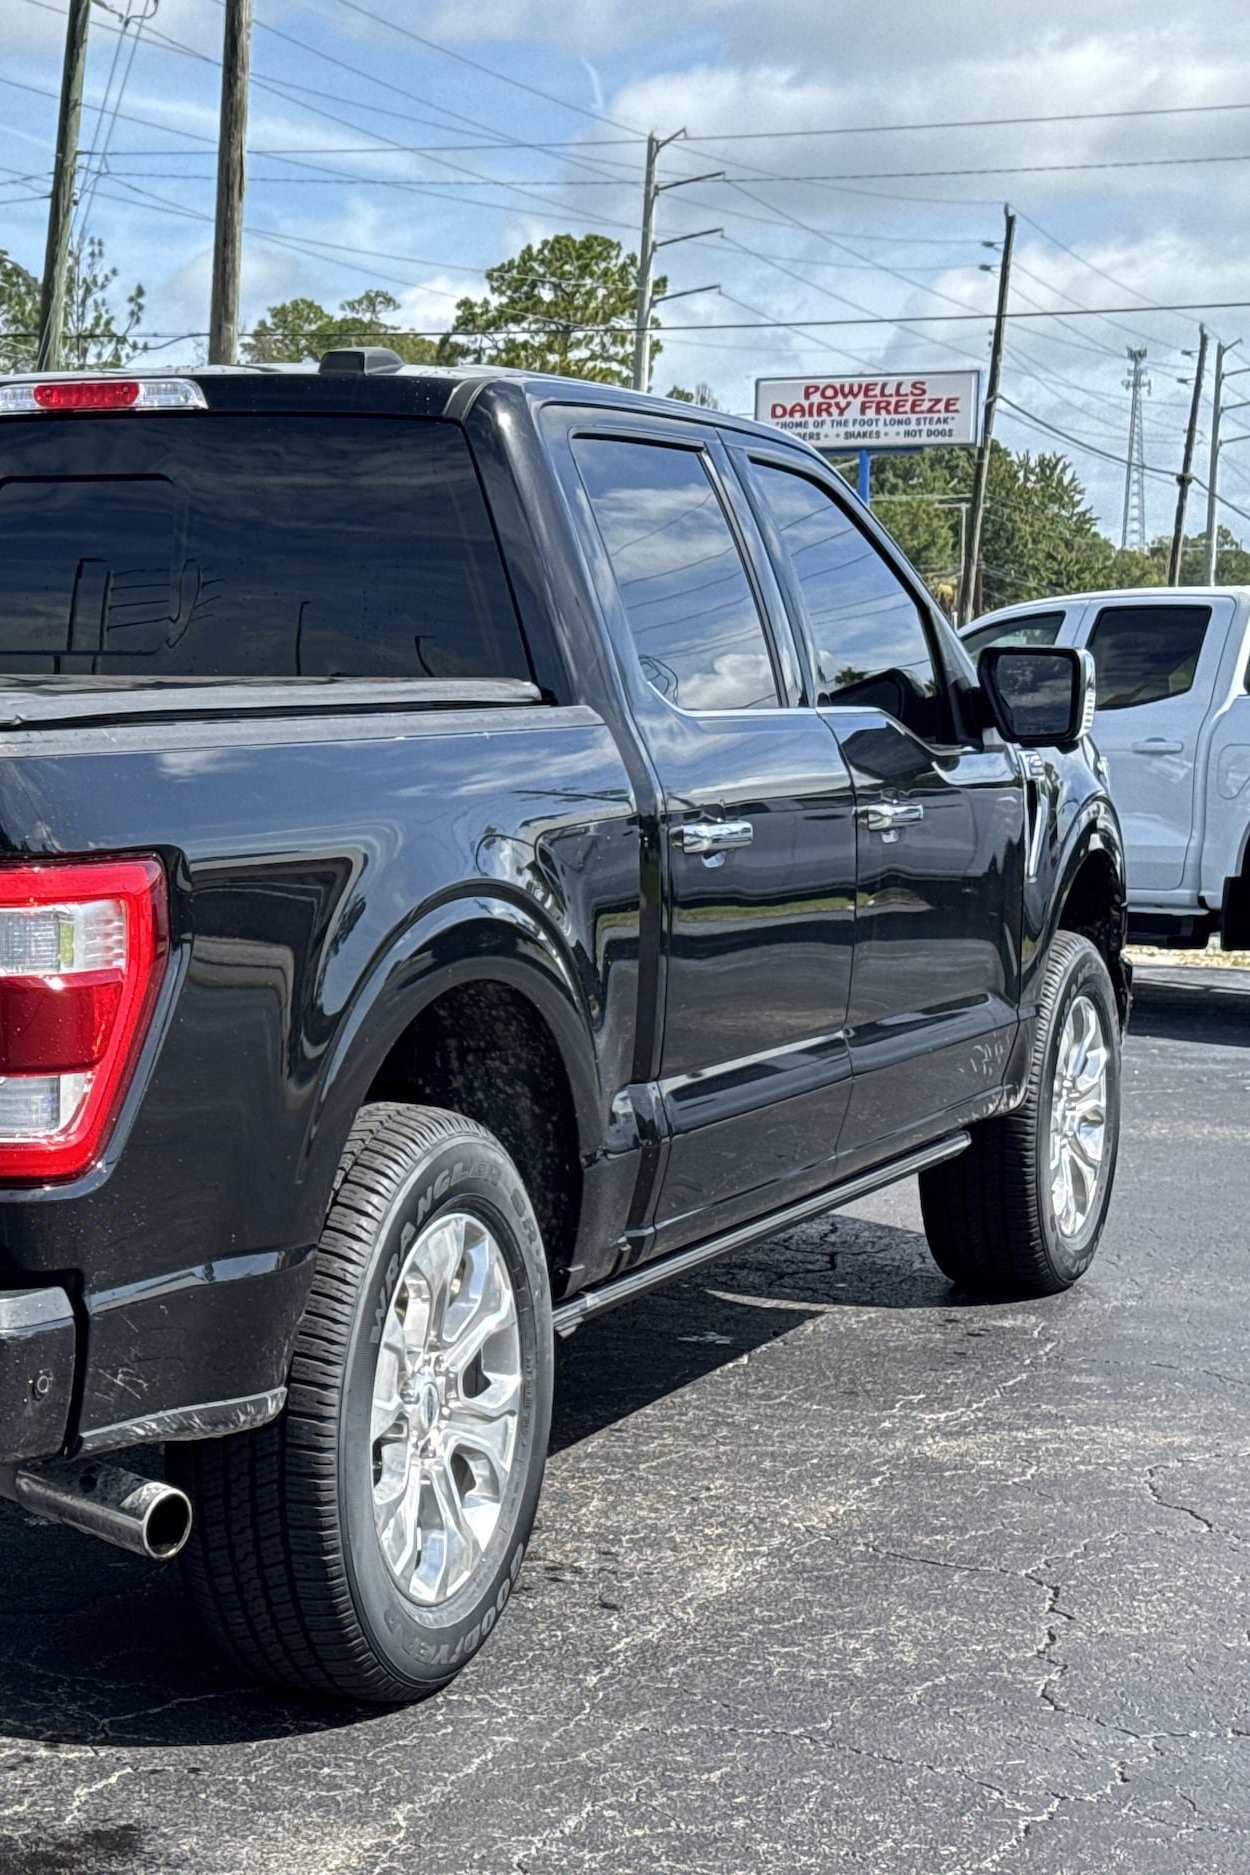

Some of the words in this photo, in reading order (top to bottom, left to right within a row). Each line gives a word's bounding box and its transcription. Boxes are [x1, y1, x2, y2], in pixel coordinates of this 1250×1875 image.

[803, 380, 927, 400] POWELLS
[770, 401, 852, 419] DAIRY
[859, 397, 961, 416] FREEZE
[812, 419, 827, 429] OF
[830, 418, 849, 429] THE
[852, 417, 881, 428] FOOT
[883, 416, 912, 427] LONG
[843, 430, 881, 440] SHAKES
[903, 429, 924, 439] HOT
[926, 428, 954, 438] DOGS
[369, 1160, 502, 1344] WRANGLER
